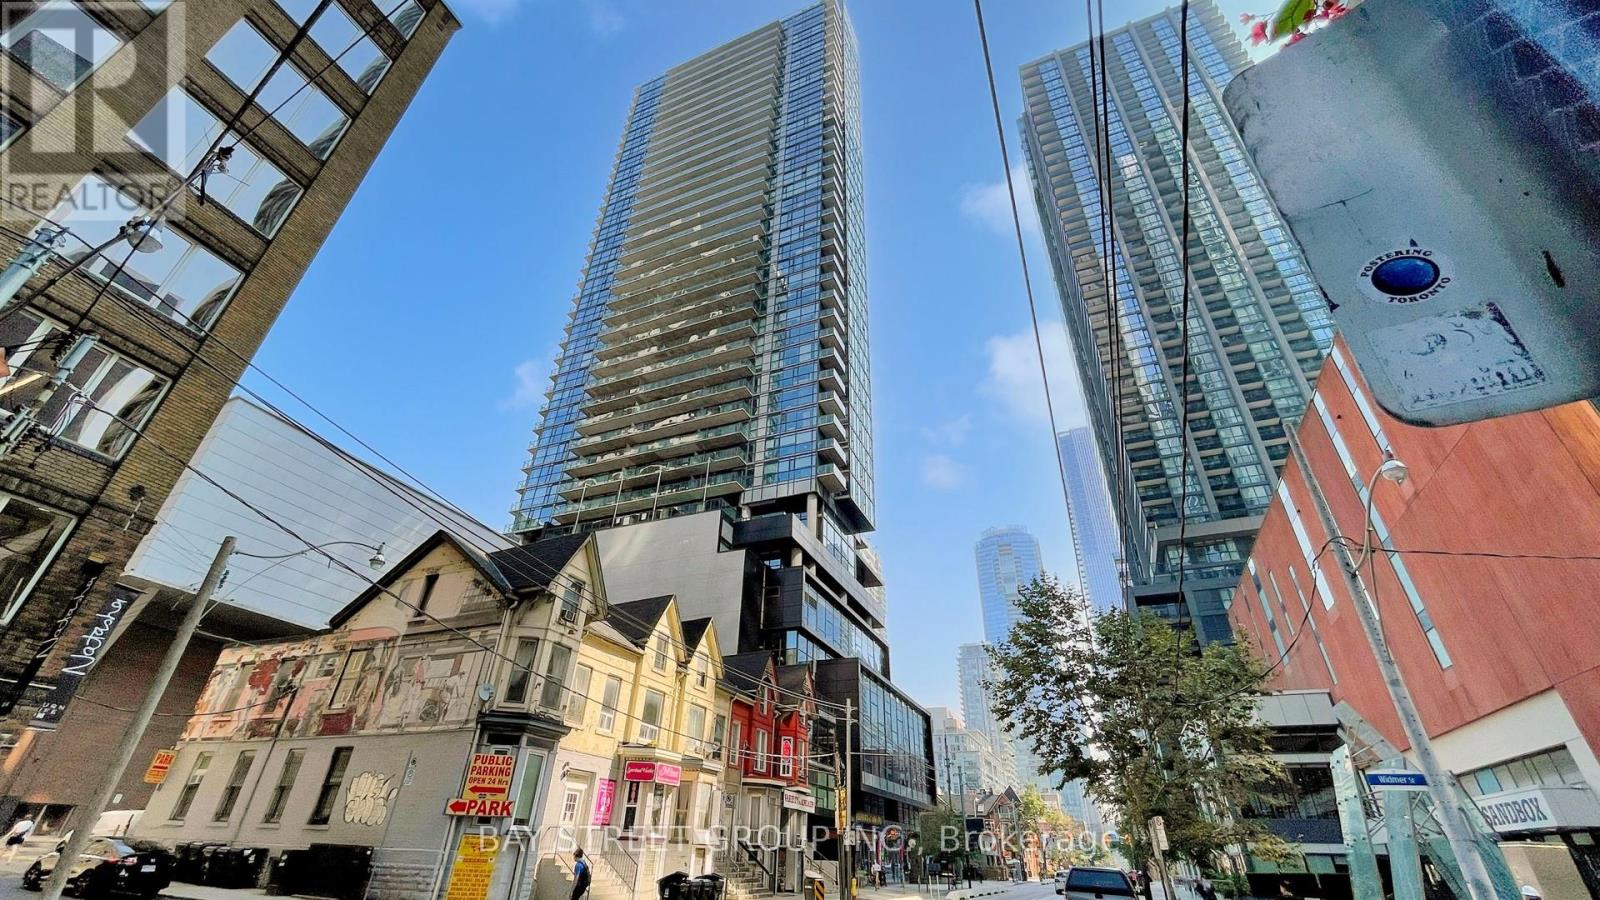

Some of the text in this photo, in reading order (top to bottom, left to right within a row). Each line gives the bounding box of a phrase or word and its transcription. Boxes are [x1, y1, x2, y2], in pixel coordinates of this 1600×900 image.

[1360, 248, 1432, 278] POSTERING
[1388, 277, 1451, 304] TORONTO
[61, 598, 128, 676] Natasha
[155, 753, 175, 765] PARK
[474, 754, 513, 766] PUBLIC
[470, 765, 511, 777] PARKING
[468, 776, 486, 785] OPEN
[487, 777, 496, 785] 24
[1378, 776, 1406, 784] Widmer
[466, 800, 513, 816] PARK
[1481, 797, 1548, 826] SANDBOX
